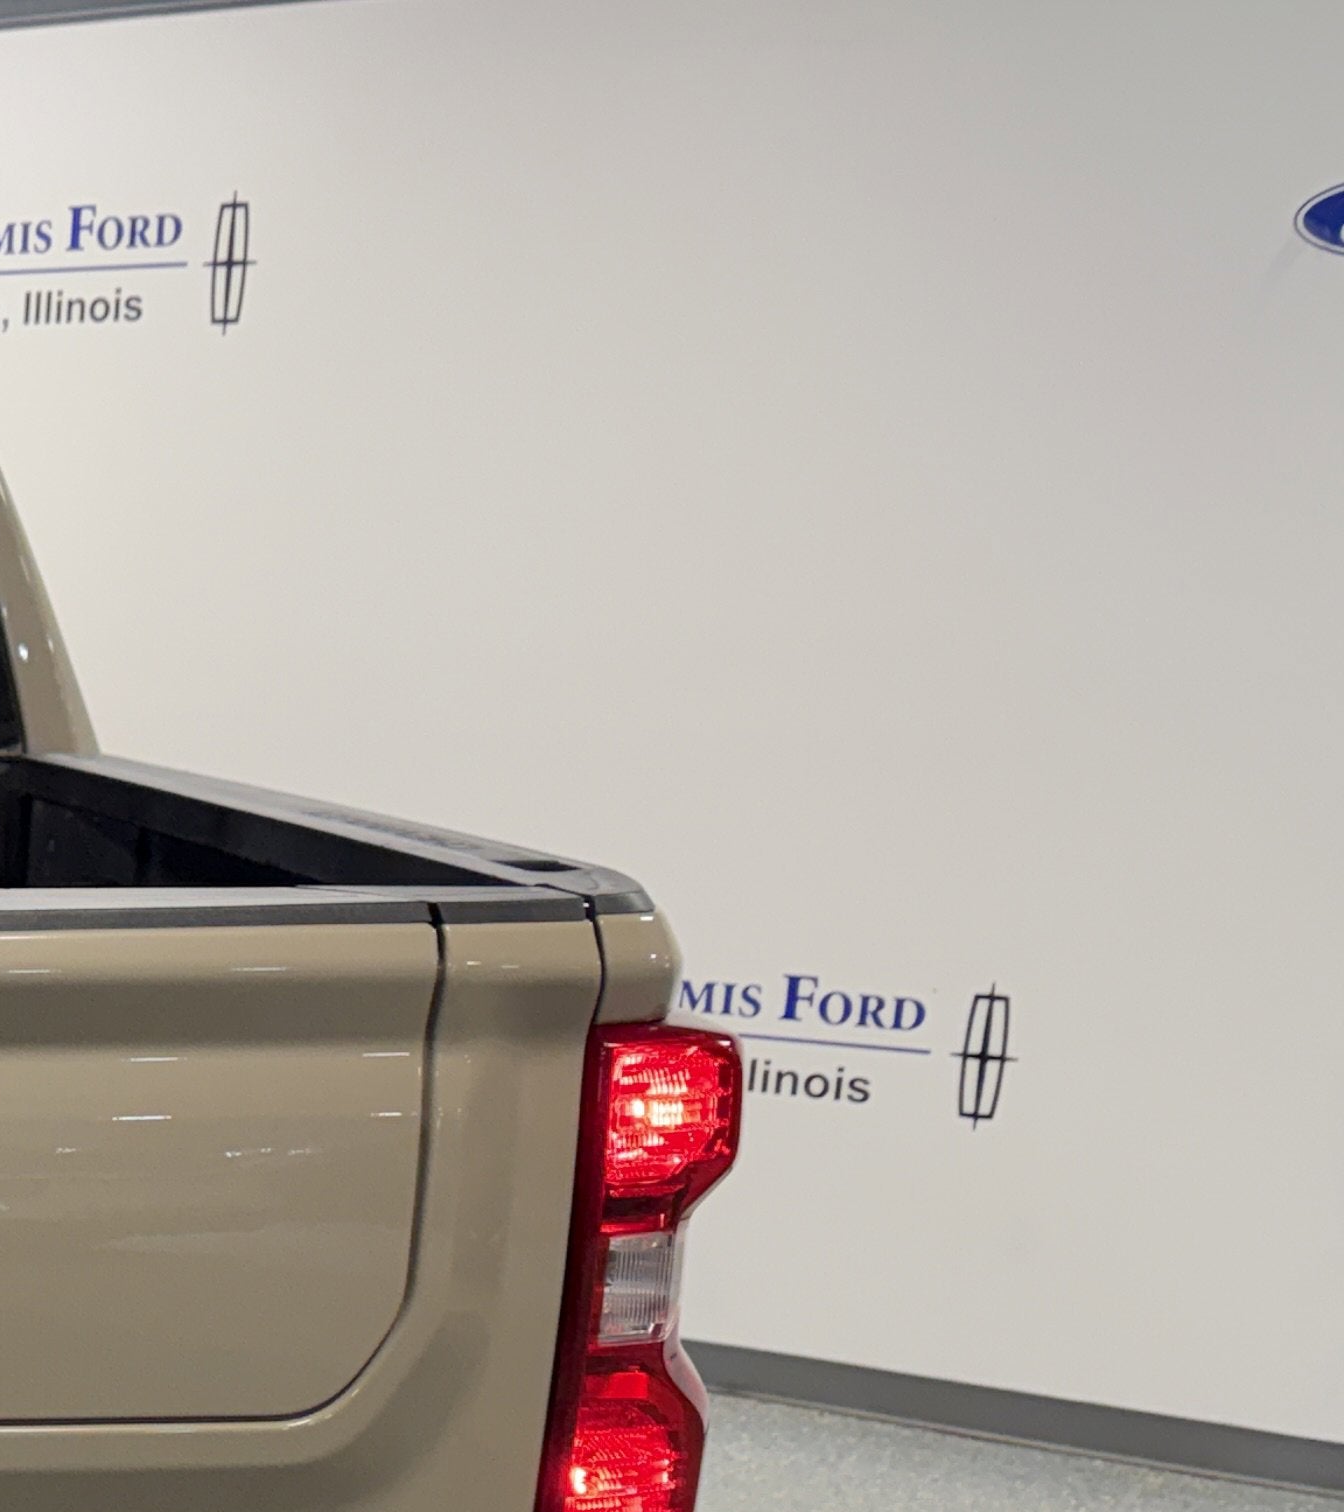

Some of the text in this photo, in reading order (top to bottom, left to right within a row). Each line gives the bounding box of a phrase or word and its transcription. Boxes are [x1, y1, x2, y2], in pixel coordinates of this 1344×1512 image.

[65, 204, 183, 253] FORD
[23, 287, 143, 325] Illinois
[679, 973, 927, 1031] MIS FORD
[747, 1058, 871, 1103] linois
